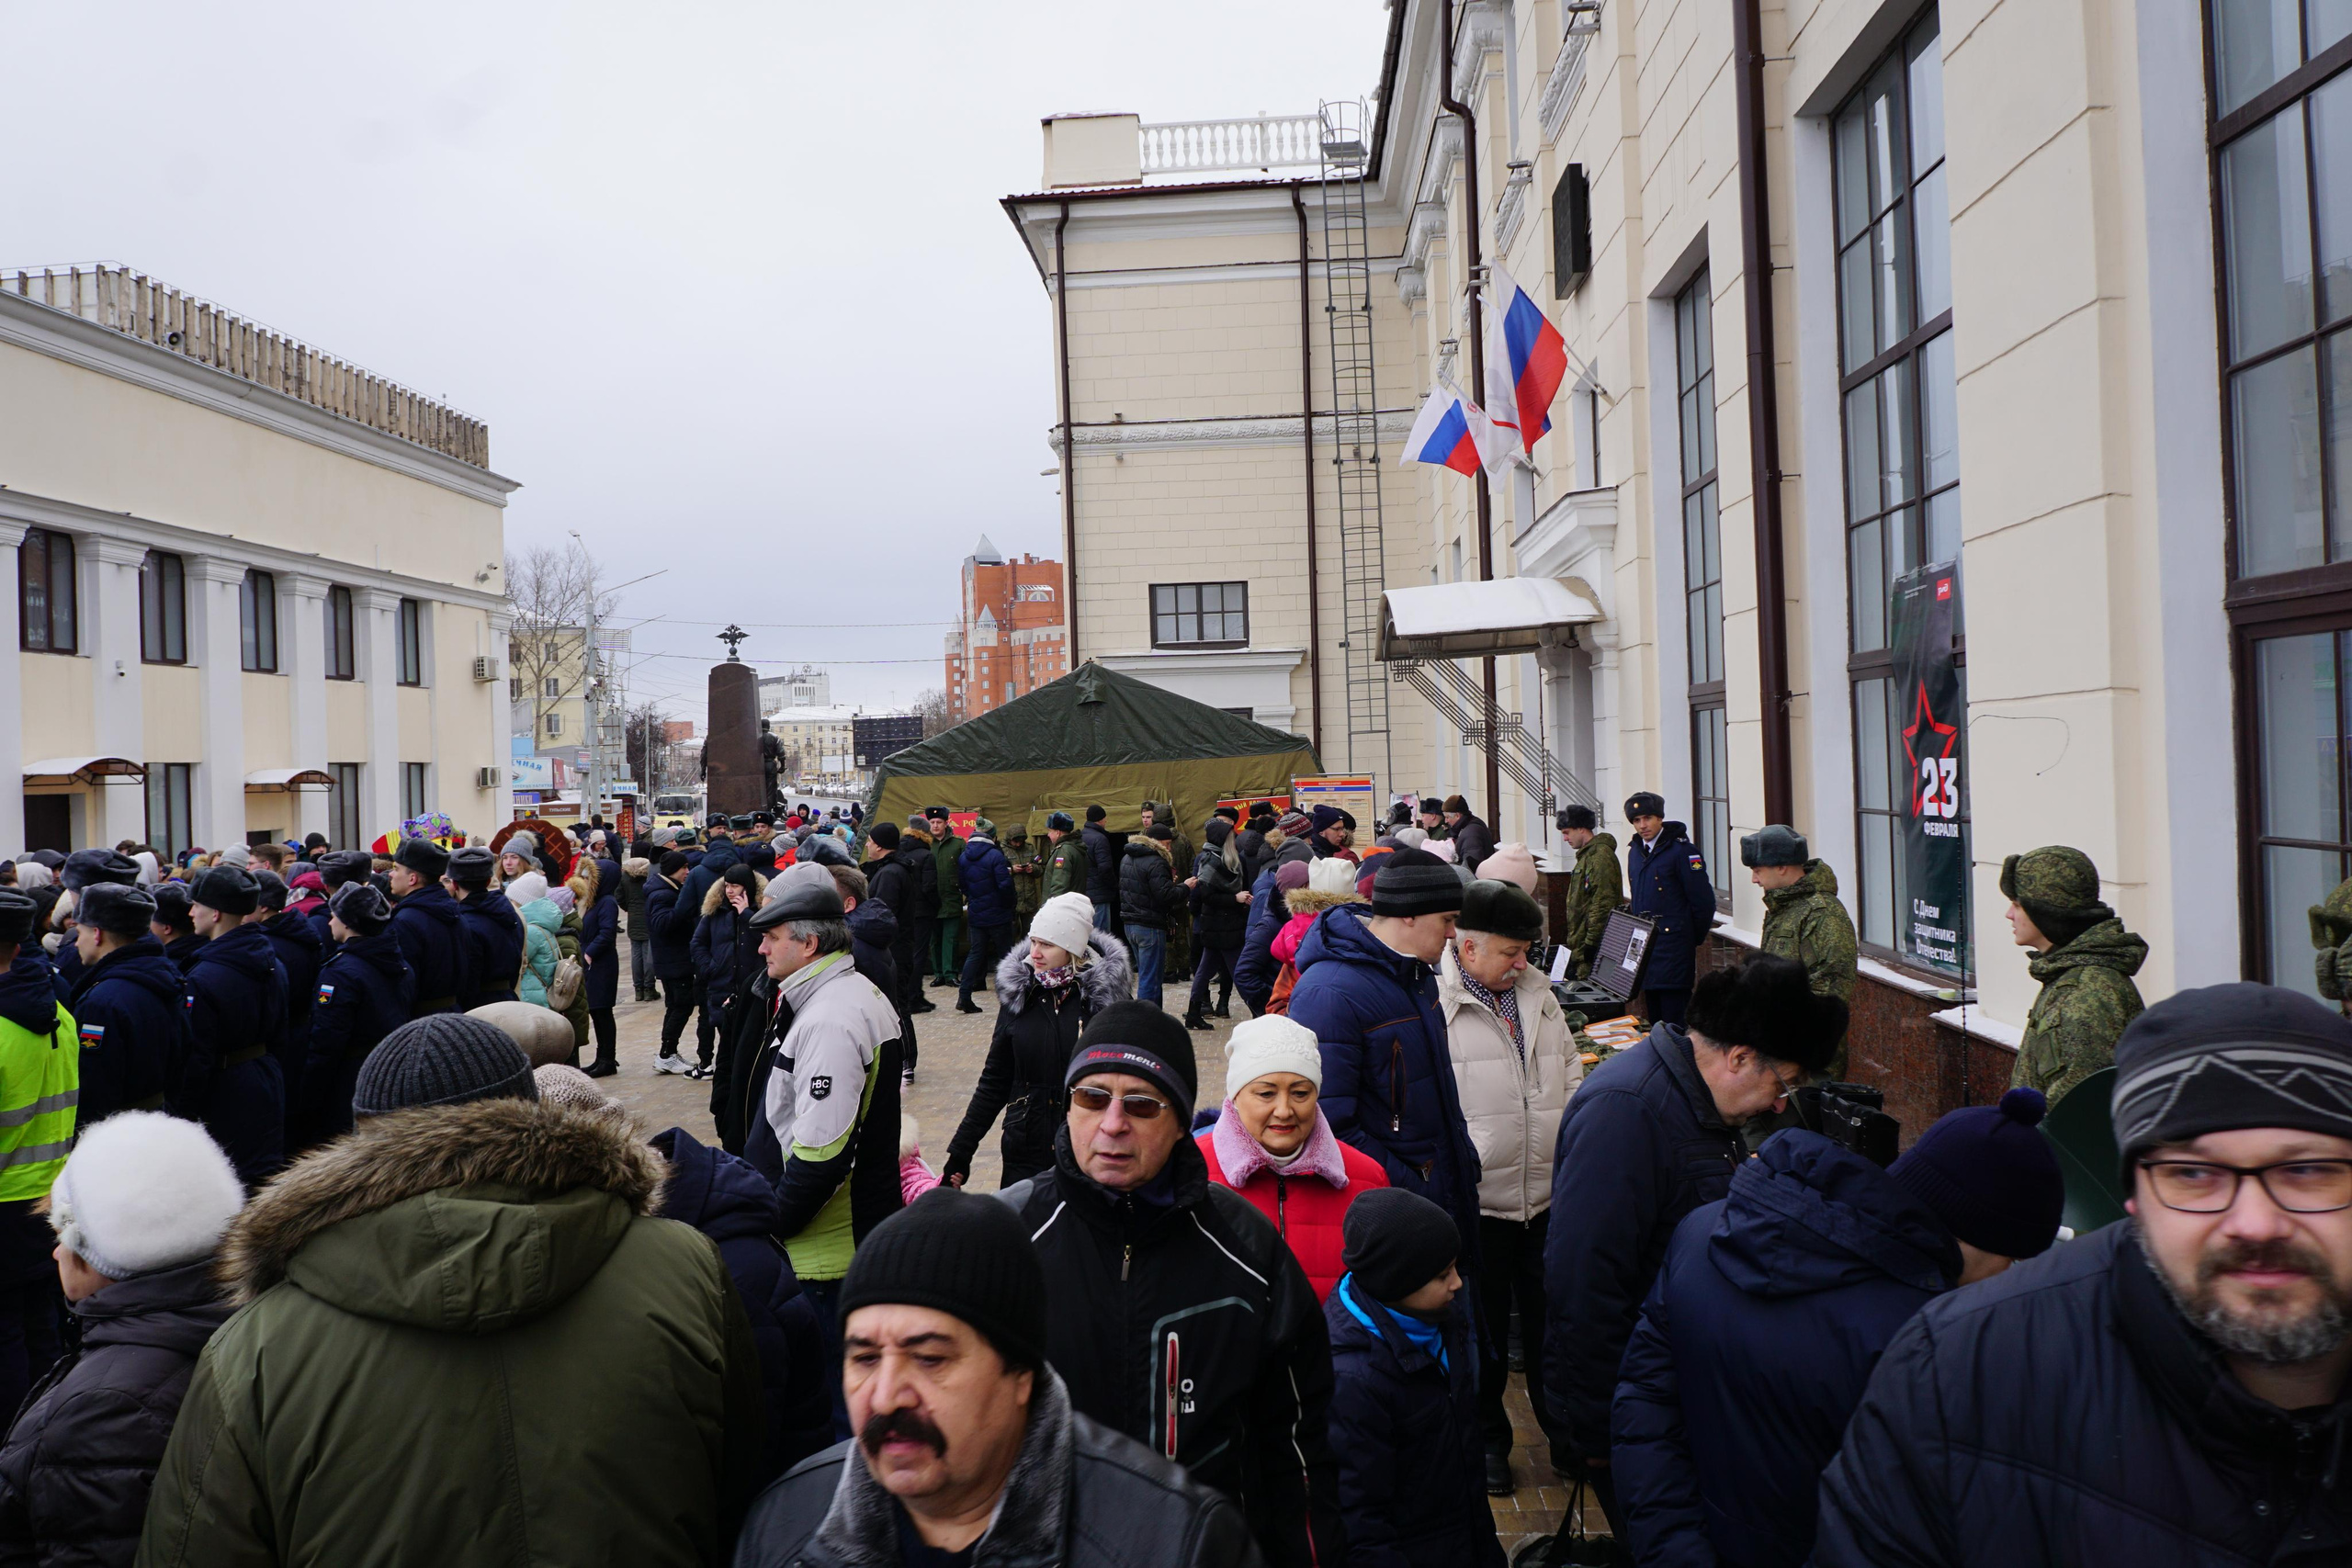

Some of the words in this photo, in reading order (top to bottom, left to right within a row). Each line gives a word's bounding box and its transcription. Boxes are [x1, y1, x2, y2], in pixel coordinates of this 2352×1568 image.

[1922, 757, 1959, 818] 23
[1923, 821, 1959, 838] ФЕВРАЛЯ
[1914, 898, 1918, 915] С
[1919, 899, 1939, 919] Днем
[1914, 922, 1956, 942] защитника
[1916, 938, 1957, 964] Отечества!
[811, 1078, 830, 1089] HBC
